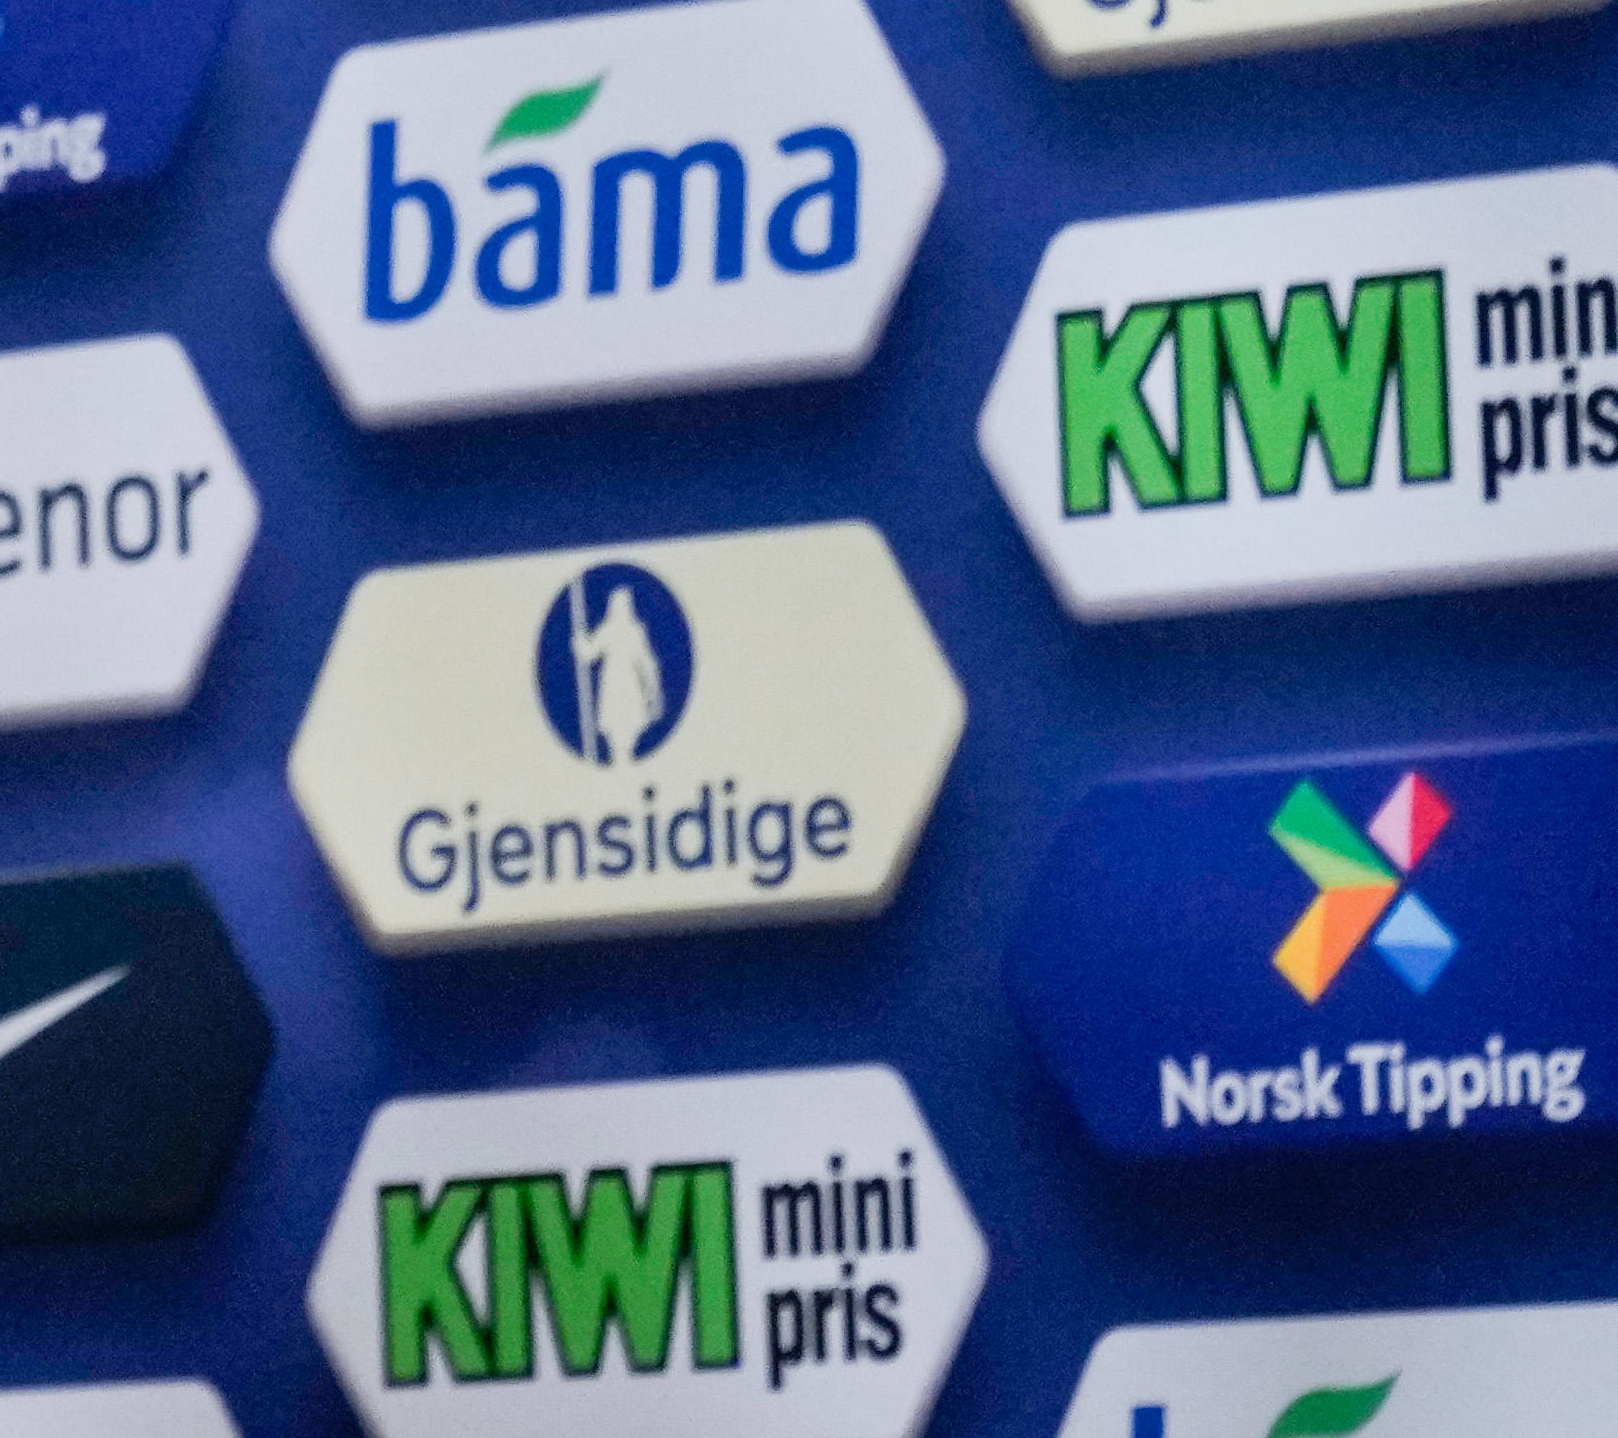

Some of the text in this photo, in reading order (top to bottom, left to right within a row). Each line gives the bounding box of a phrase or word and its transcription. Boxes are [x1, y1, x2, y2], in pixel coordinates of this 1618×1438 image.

[362, 125, 862, 326] bama
[1057, 268, 1452, 519] KIWI
[397, 779, 855, 912] Gjensidige
[1158, 1033, 1587, 1130] Norsk Tipping
[759, 1148, 921, 1261] mini
[378, 1159, 742, 1390] KIWI
[766, 1263, 903, 1391] pris
